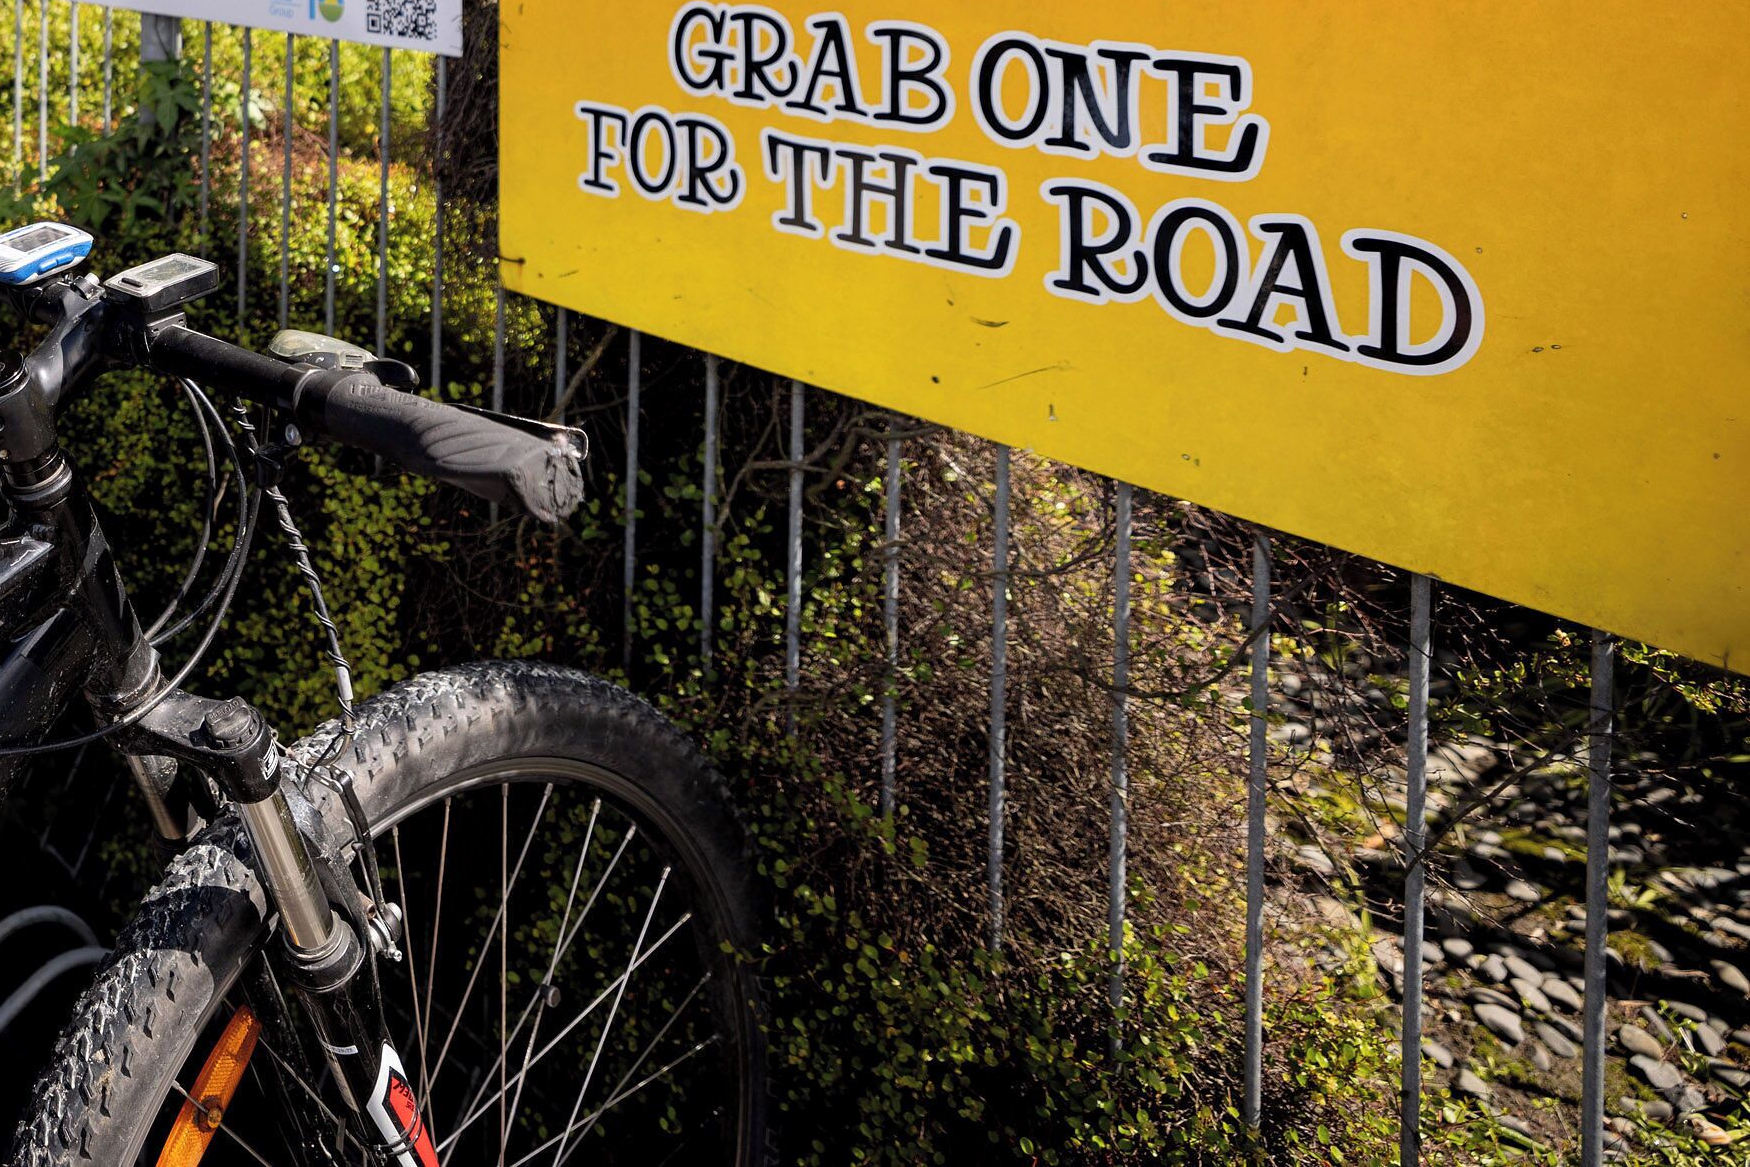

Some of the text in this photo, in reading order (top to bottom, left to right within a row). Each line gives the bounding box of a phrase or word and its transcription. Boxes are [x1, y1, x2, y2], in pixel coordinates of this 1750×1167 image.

[269, 6, 295, 19] Group
[670, 1, 1270, 183] GRAB ONE
[576, 99, 1486, 376] FOR THE ROAD
